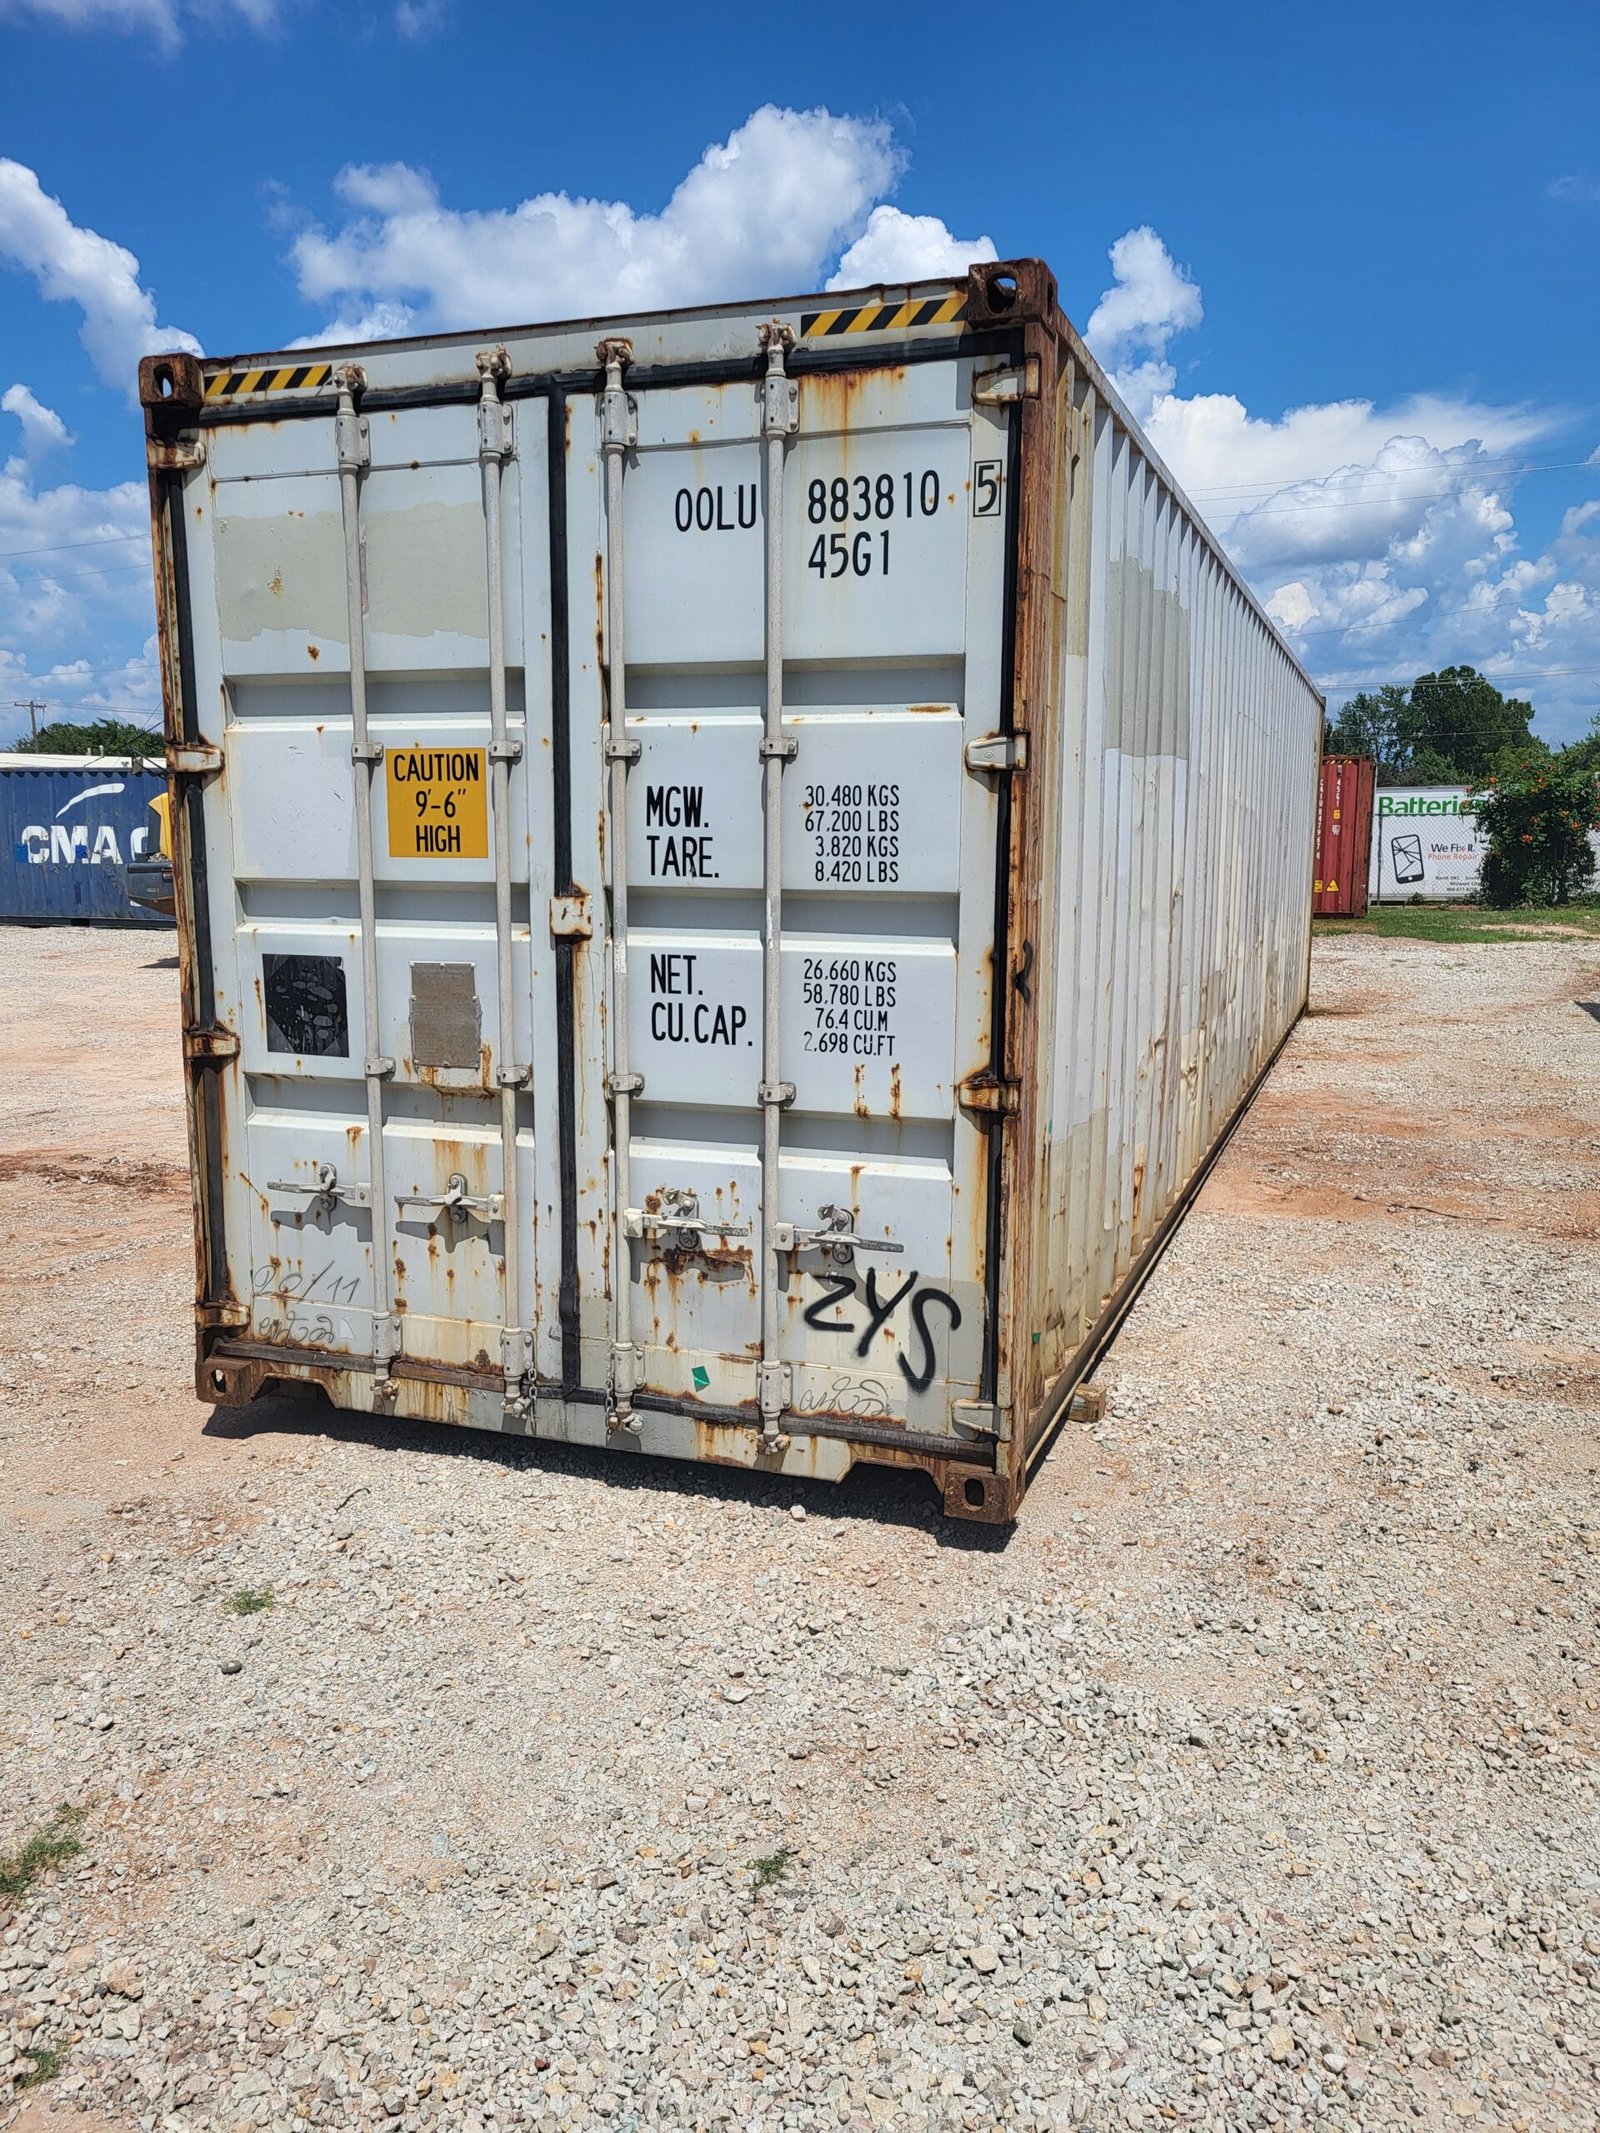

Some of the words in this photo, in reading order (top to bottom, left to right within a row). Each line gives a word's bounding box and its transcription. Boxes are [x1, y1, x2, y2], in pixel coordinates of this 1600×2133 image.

[675, 484, 757, 532] OOLU
[808, 469, 940, 524] 883810
[976, 464, 998, 514] 5
[808, 530, 889, 579] 45G1
[393, 753, 479, 782] CAUTION
[645, 785, 709, 828] MGW.
[804, 785, 862, 807] 30,480
[867, 784, 900, 807] KGS
[1379, 795, 1483, 817] Batteri
[805, 810, 862, 832] 67,200
[867, 810, 900, 832] LBS
[22, 825, 124, 865] CMA
[415, 825, 461, 853] HIGH
[1431, 843, 1449, 853] We
[1450, 843, 1466, 853] Fix
[646, 834, 720, 878] TARE.
[815, 835, 862, 857] 3,820
[867, 835, 899, 857] KGS
[1427, 853, 1452, 861] Phone
[1453, 853, 1478, 862] Repair
[815, 860, 862, 882] 8,420
[867, 860, 899, 882] LBS
[650, 953, 704, 996] NET.
[803, 958, 860, 981] 26,660
[865, 960, 897, 983] KGS
[803, 982, 860, 1006] 58,780
[864, 984, 896, 1008] LBS
[815, 1007, 849, 1030] 76.4
[853, 1009, 888, 1032] CU.M
[853, 1033, 896, 1057] CU.FT
